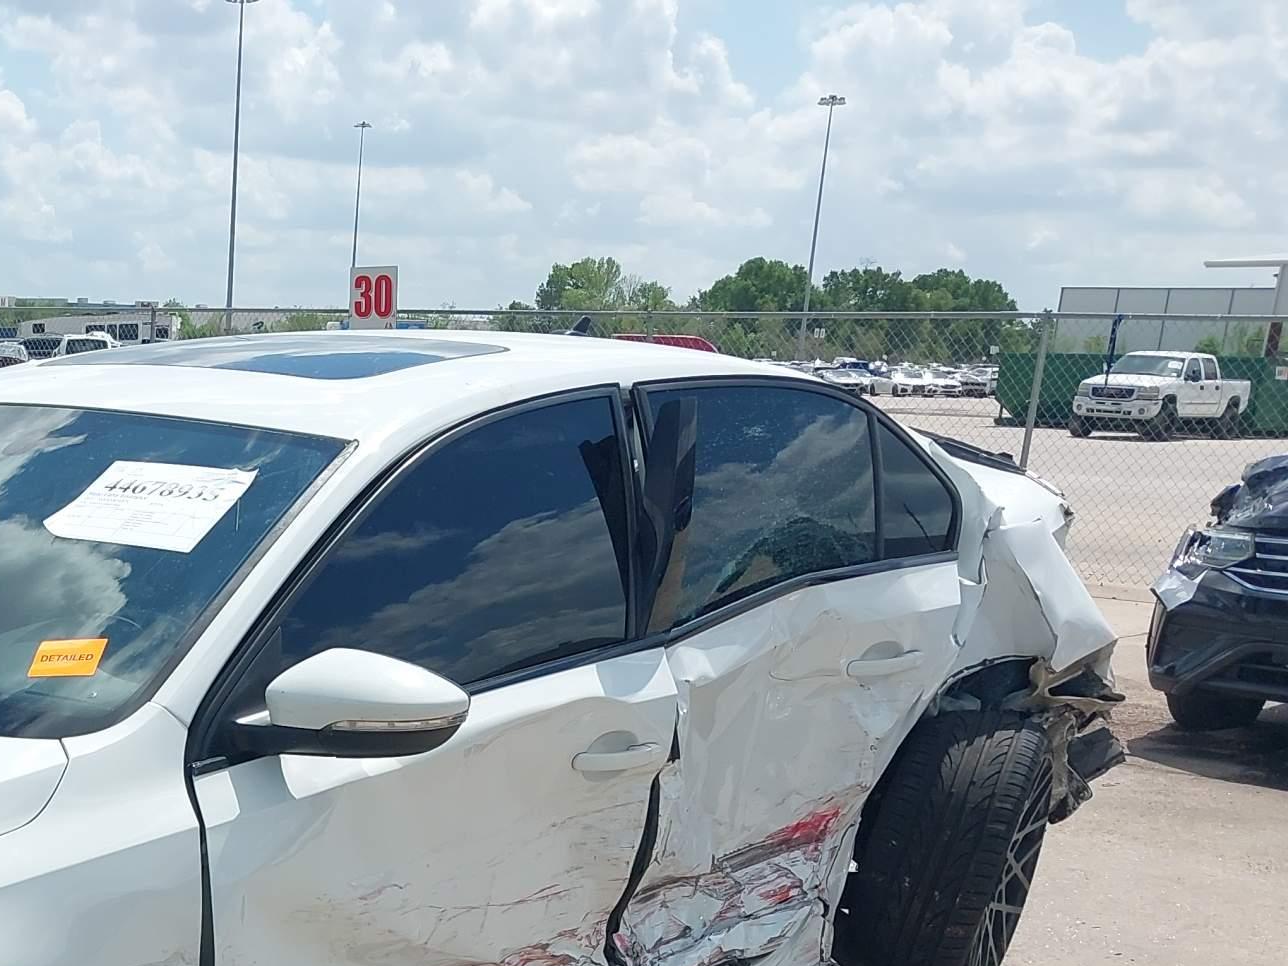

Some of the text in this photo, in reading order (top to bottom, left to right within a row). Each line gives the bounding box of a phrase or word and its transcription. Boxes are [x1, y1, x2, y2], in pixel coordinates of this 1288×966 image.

[354, 274, 393, 318] 30
[104, 478, 225, 502] 44678935
[40, 652, 94, 664] DETAILED
